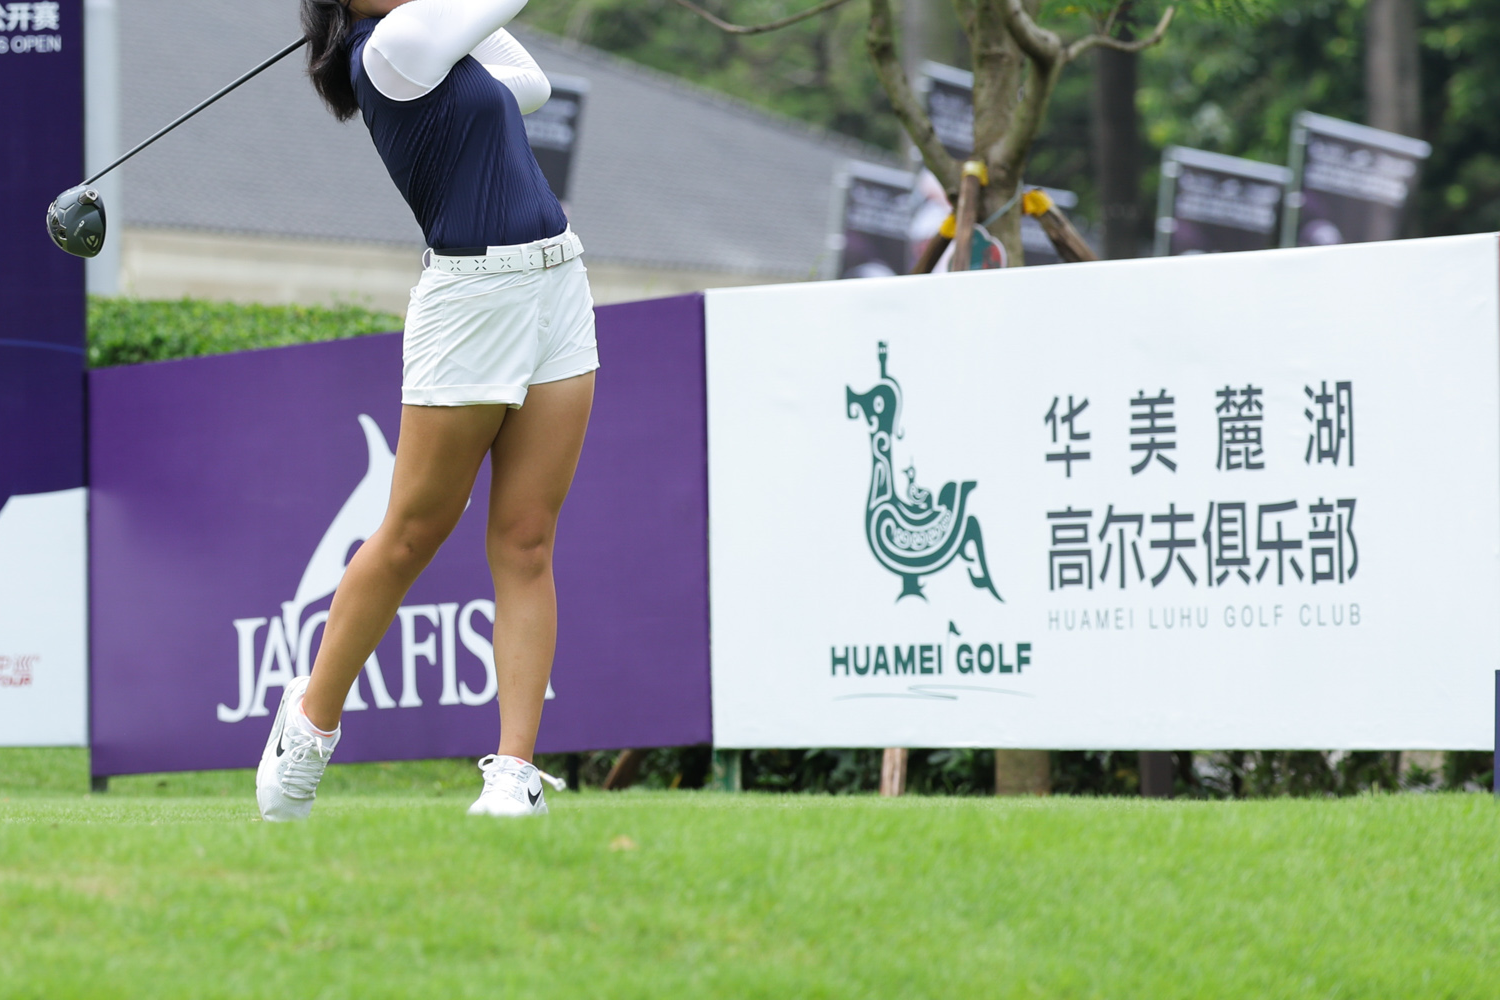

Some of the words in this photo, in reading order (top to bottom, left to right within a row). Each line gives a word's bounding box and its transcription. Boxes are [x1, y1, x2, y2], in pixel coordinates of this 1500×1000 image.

[10, 34, 62, 53] OPEN
[1044, 380, 1355, 478] 华美麓湖
[1046, 497, 1359, 592] 高尔夫俱乐部
[1048, 607, 1134, 631] HUAMEI
[1148, 605, 1209, 630] LUHU
[1223, 603, 1283, 628] GOLF
[1298, 602, 1361, 628] CLUB
[830, 645, 943, 676] HUAMEI
[955, 643, 1032, 674] GOLF
